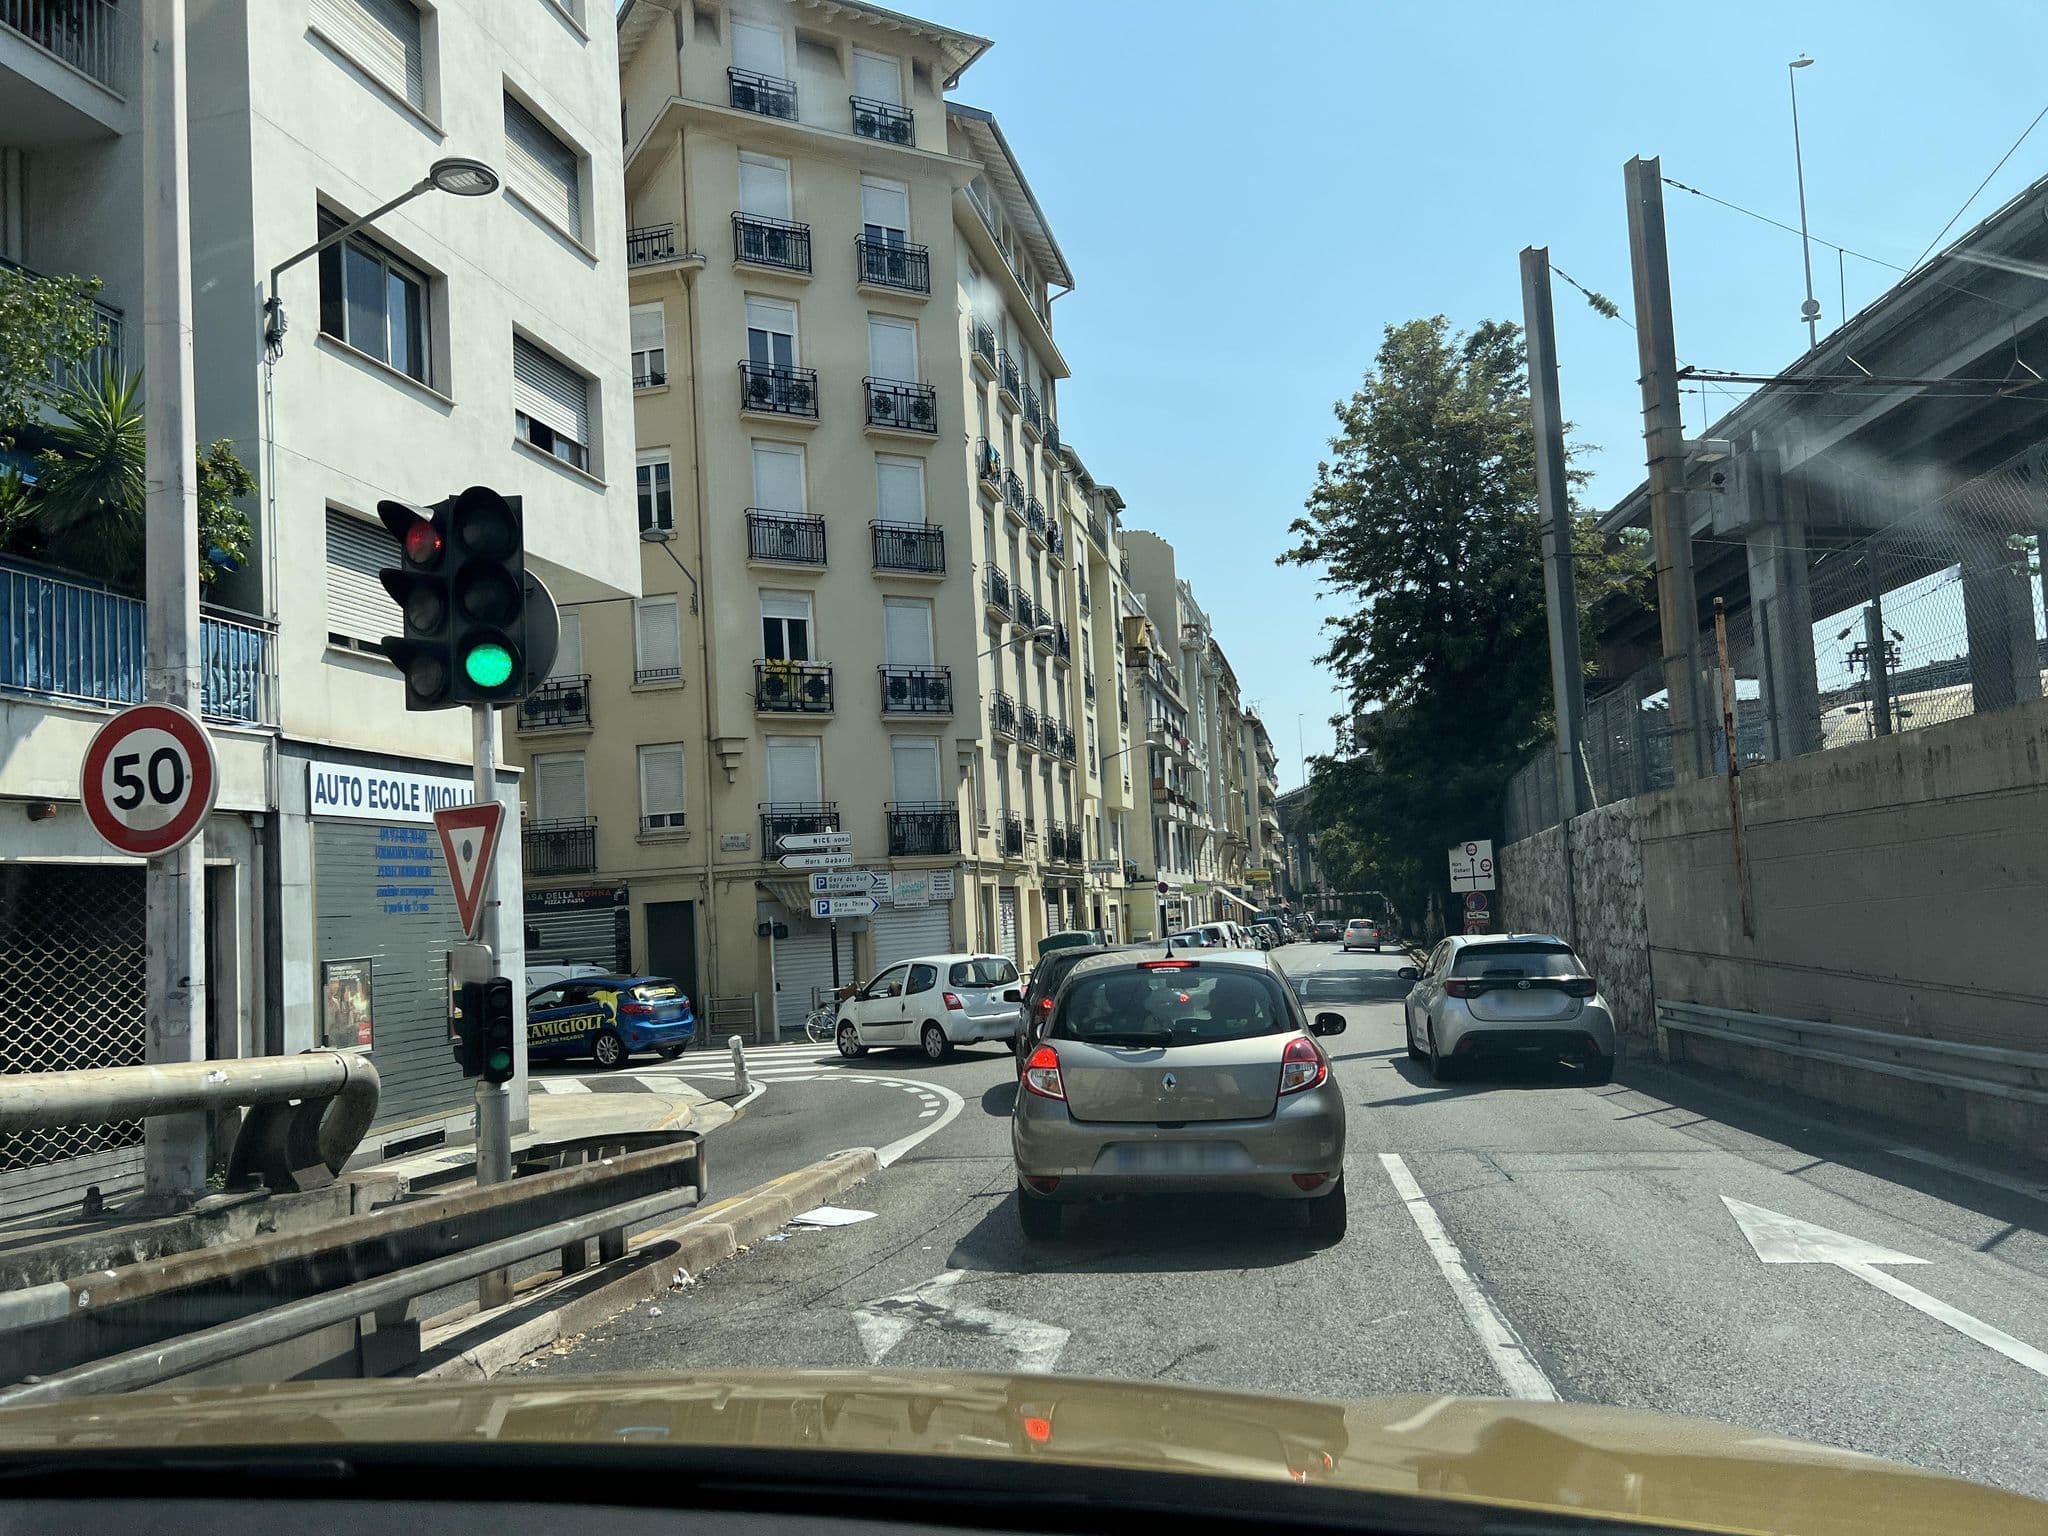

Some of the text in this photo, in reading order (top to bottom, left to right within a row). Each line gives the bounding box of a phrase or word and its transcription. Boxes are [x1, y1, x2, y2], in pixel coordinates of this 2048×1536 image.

[113, 747, 184, 810] 50
[315, 773, 362, 807] AUTO
[368, 779, 420, 812] ECOLE
[546, 891, 575, 900] DELLA
